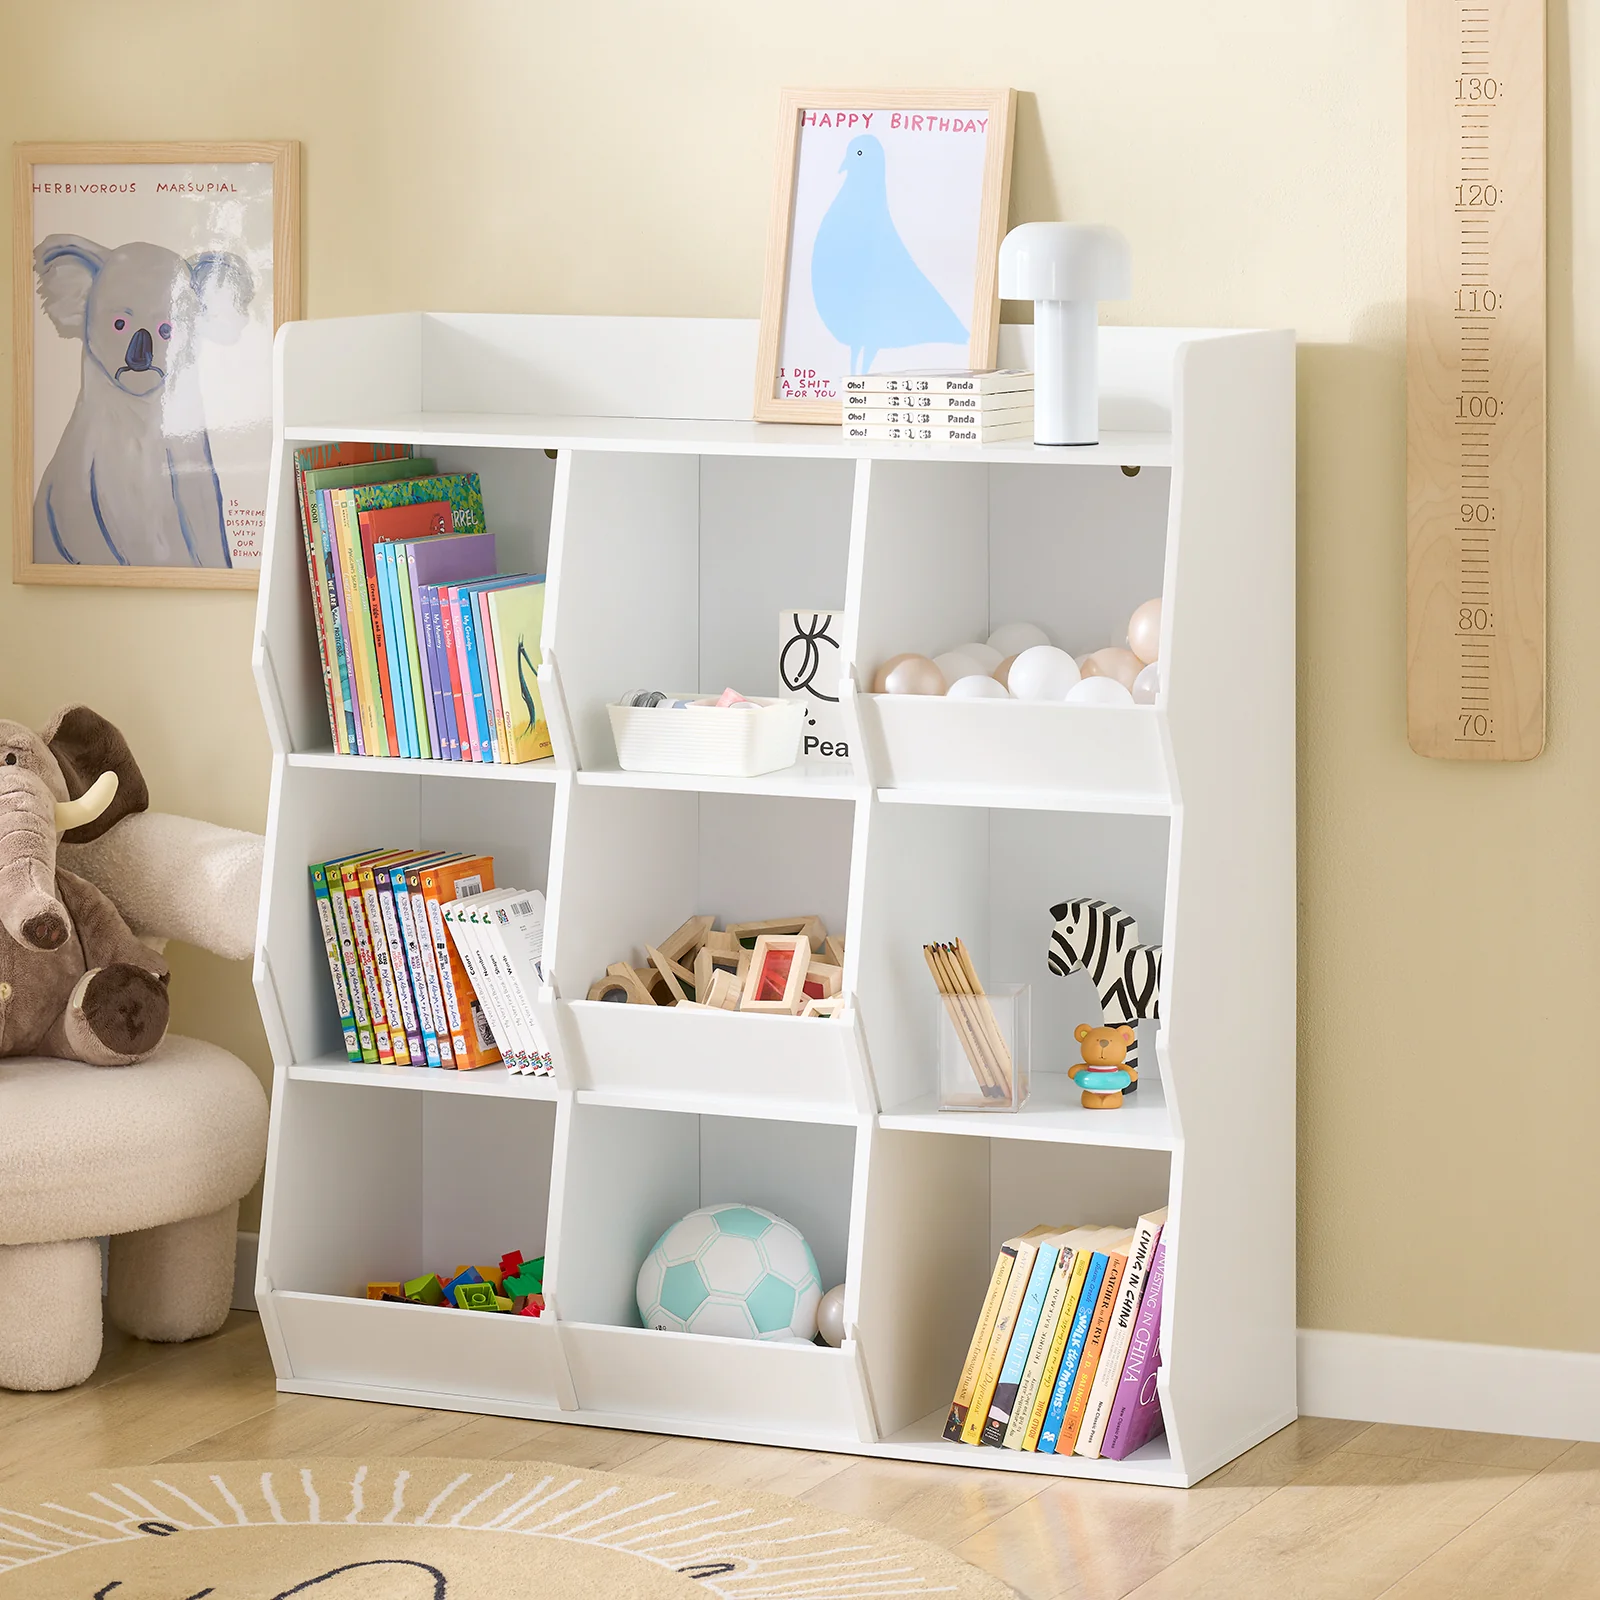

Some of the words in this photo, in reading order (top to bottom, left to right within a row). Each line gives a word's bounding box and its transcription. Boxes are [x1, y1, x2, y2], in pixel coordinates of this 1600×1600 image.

[802, 110, 873, 129] HAPPY
[890, 112, 988, 133] BIRTHDAY
[32, 182, 136, 194] HERBIVOROUS
[156, 182, 237, 193] MARSUPIAL
[781, 368, 785, 377] I
[794, 368, 816, 378] DID
[782, 380, 790, 389] A
[799, 379, 830, 388] SHIT
[946, 381, 974, 390] Panda
[949, 398, 976, 407] Panda
[848, 413, 866, 421] Oho!
[947, 415, 975, 424] Panda
[850, 429, 867, 437] Oho!
[949, 430, 976, 439] Panda
[308, 502, 318, 523] Soon
[328, 579, 334, 590] WE
[424, 613, 429, 623] My
[433, 614, 439, 624] My
[443, 619, 450, 629] My
[463, 614, 470, 625] My
[804, 736, 849, 757] Pea
[320, 901, 329, 922] KINNEY
[336, 896, 345, 919] KINNEY
[353, 900, 361, 922] KINNEY
[368, 893, 377, 917] KINNEY
[383, 896, 392, 919] KINNEY
[401, 896, 410, 920] KINNEY
[415, 898, 424, 923] KINNEY
[431, 901, 439, 924] KINNEY
[465, 955, 476, 975] Colors
[476, 950, 489, 976] Numbers
[490, 955, 500, 974] Shapes
[503, 955, 513, 974] Words
[340, 998, 348, 1013] Diary
[357, 1006, 366, 1022] Diary
[390, 1009, 398, 1027] Diary
[405, 1012, 413, 1029] Diary
[423, 1012, 431, 1029] Diary
[436, 1015, 444, 1032] Diary
[451, 1010, 459, 1028] Diary
[1132, 1230, 1151, 1271] LIVING
[1036, 1251, 1050, 1288] ESSAYS
[1101, 1269, 1118, 1309] CATCHER
[1129, 1273, 1140, 1287] IN
[1147, 1252, 1166, 1308] INVESTING
[1029, 1291, 1041, 1304] of
[1026, 1305, 1037, 1316] E.
[1118, 1290, 1135, 1328] CHINA
[1142, 1311, 1152, 1325] IN
[1022, 1317, 1033, 1328] B.
[1033, 1332, 1047, 1364] FREDRIK
[1044, 1288, 1060, 1328] BACKMAN
[1072, 1314, 1087, 1348] WALK
[1092, 1327, 1102, 1344] RYE
[1008, 1332, 1029, 1377] WHITE
[1065, 1349, 1079, 1369] two
[1124, 1328, 1150, 1382] CHINA
[1084, 1361, 1091, 1369] D.
[1053, 1369, 1073, 1408] moons
[1072, 1373, 1088, 1412] SALINGER
[1028, 1418, 1040, 1438] ROALD
[1035, 1401, 1045, 1417] DAHL
[1092, 1412, 1100, 1429] Classic
[1115, 1418, 1123, 1434] Classic
